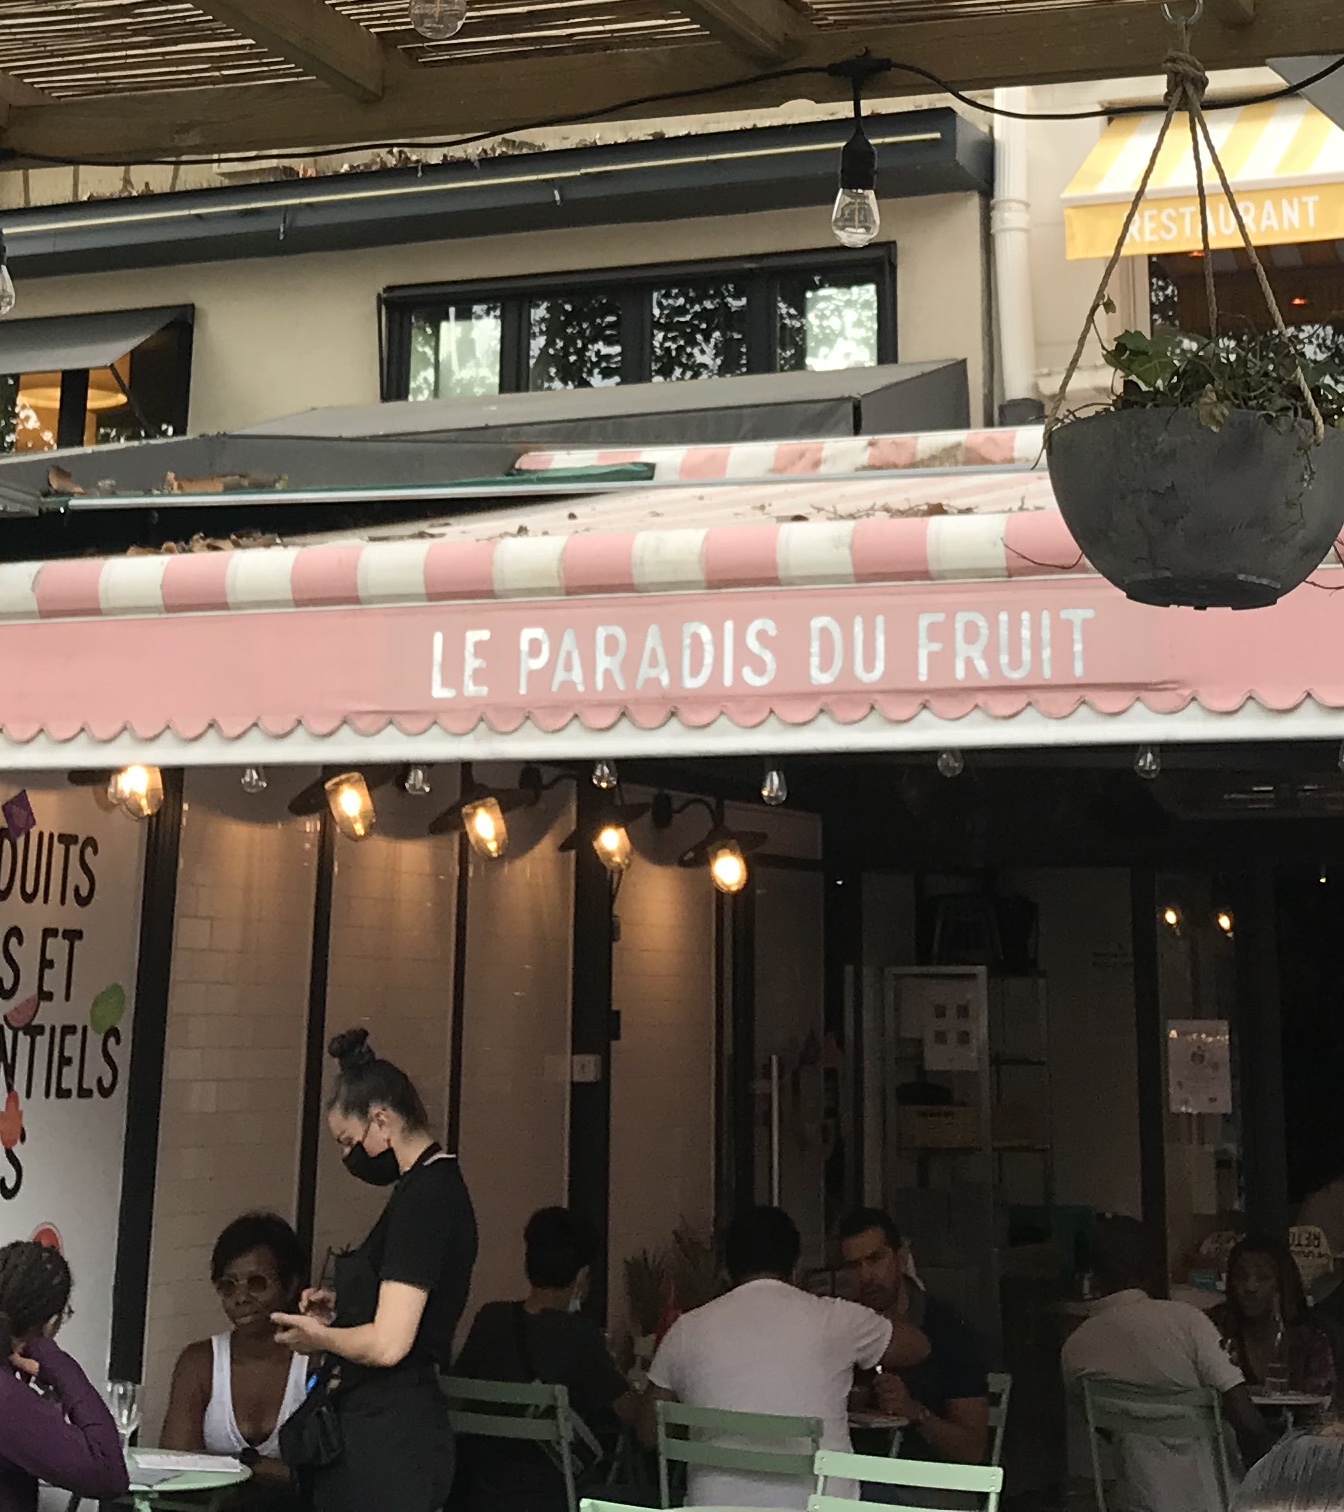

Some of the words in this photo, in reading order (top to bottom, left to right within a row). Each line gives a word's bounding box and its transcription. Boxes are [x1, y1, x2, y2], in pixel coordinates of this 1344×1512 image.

[1123, 195, 1320, 244] RESTAURANT
[431, 629, 491, 698] LE
[518, 618, 778, 695] PARADIS
[809, 614, 886, 685] DU
[917, 608, 1096, 682] FRUIT
[37, 927, 84, 1003] ET
